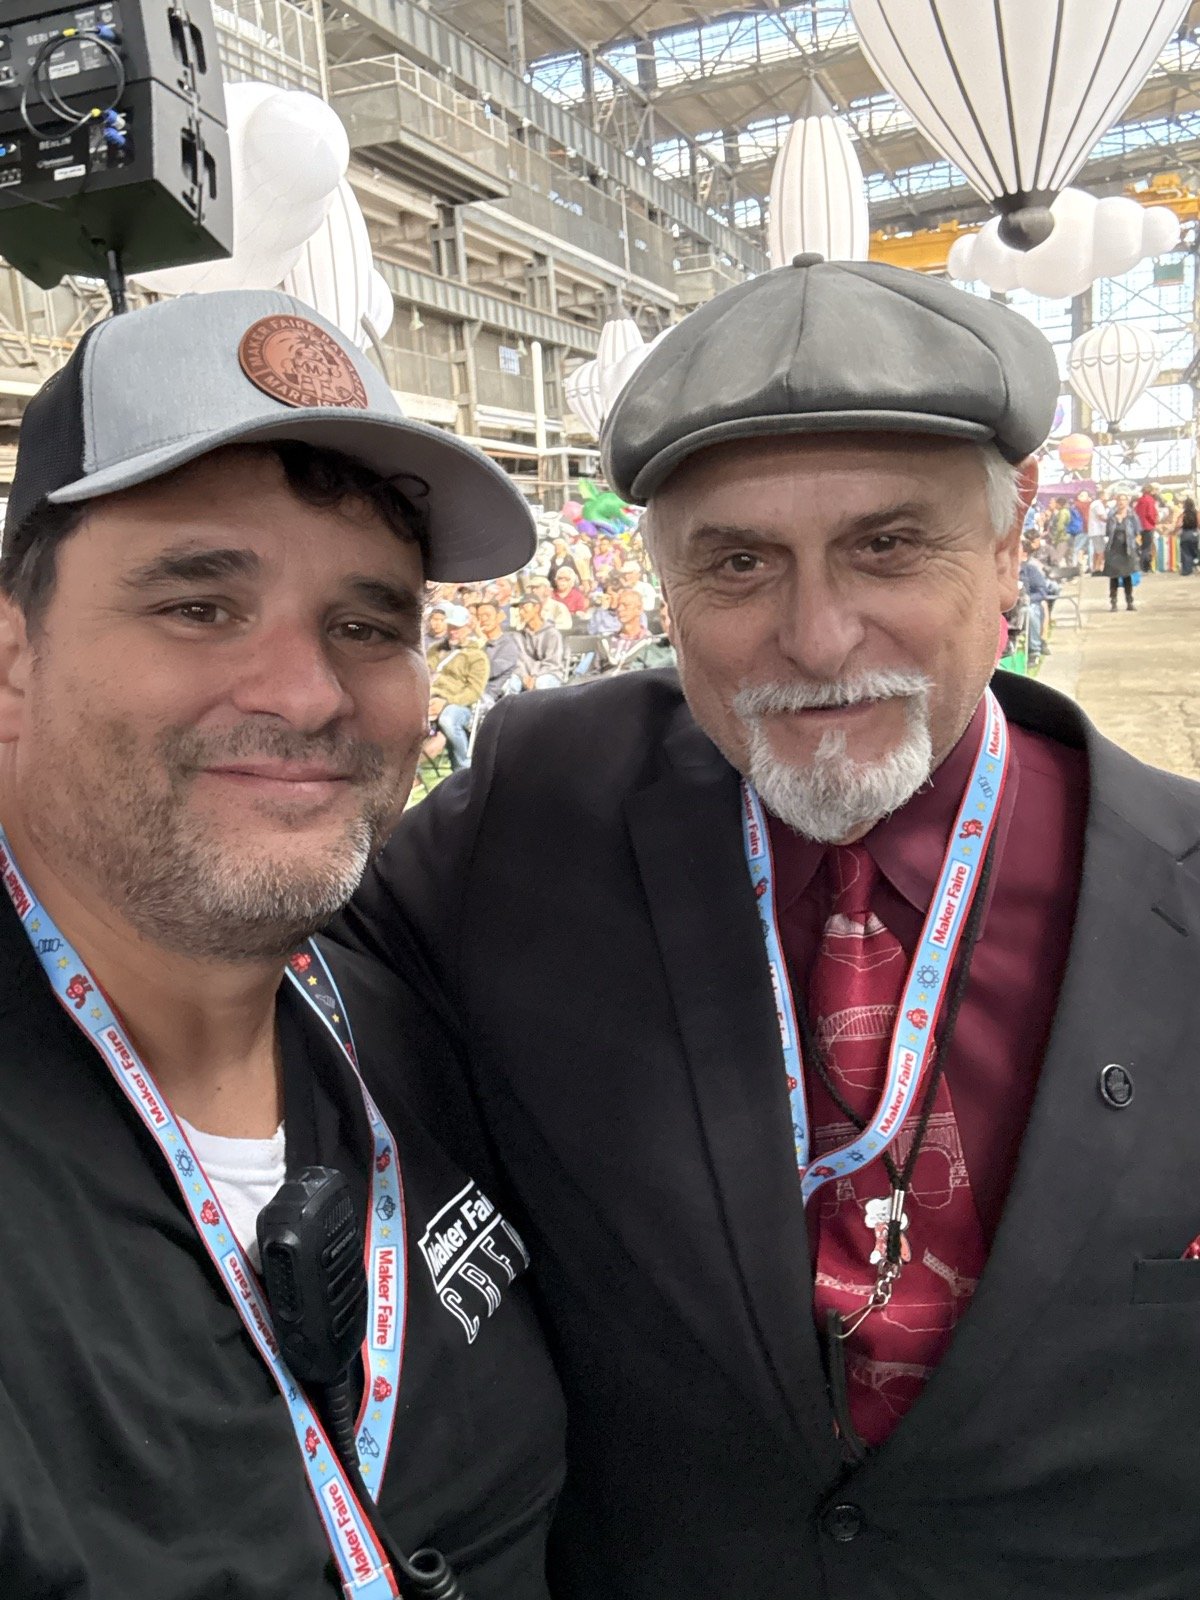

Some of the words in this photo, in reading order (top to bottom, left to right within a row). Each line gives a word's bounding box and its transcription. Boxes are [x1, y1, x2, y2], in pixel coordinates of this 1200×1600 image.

[247, 325, 271, 367] MAKER
[269, 319, 316, 333] FAIRE
[264, 375, 311, 405] MARE
[749, 823, 761, 856] Faire
[6, 870, 32, 918] Maker
[932, 900, 956, 944] Maker
[947, 865, 967, 899] Faire
[107, 1030, 135, 1071] Faire
[131, 1072, 166, 1124] Maker
[880, 1087, 905, 1134] Maker
[897, 1053, 914, 1088] Faire
[428, 1218, 468, 1277] Maker
[229, 1256, 252, 1301] Faire
[378, 1249, 394, 1302] Maker
[376, 1305, 392, 1346] Faire
[328, 1483, 352, 1529] Faire
[344, 1528, 374, 1583] Maker
